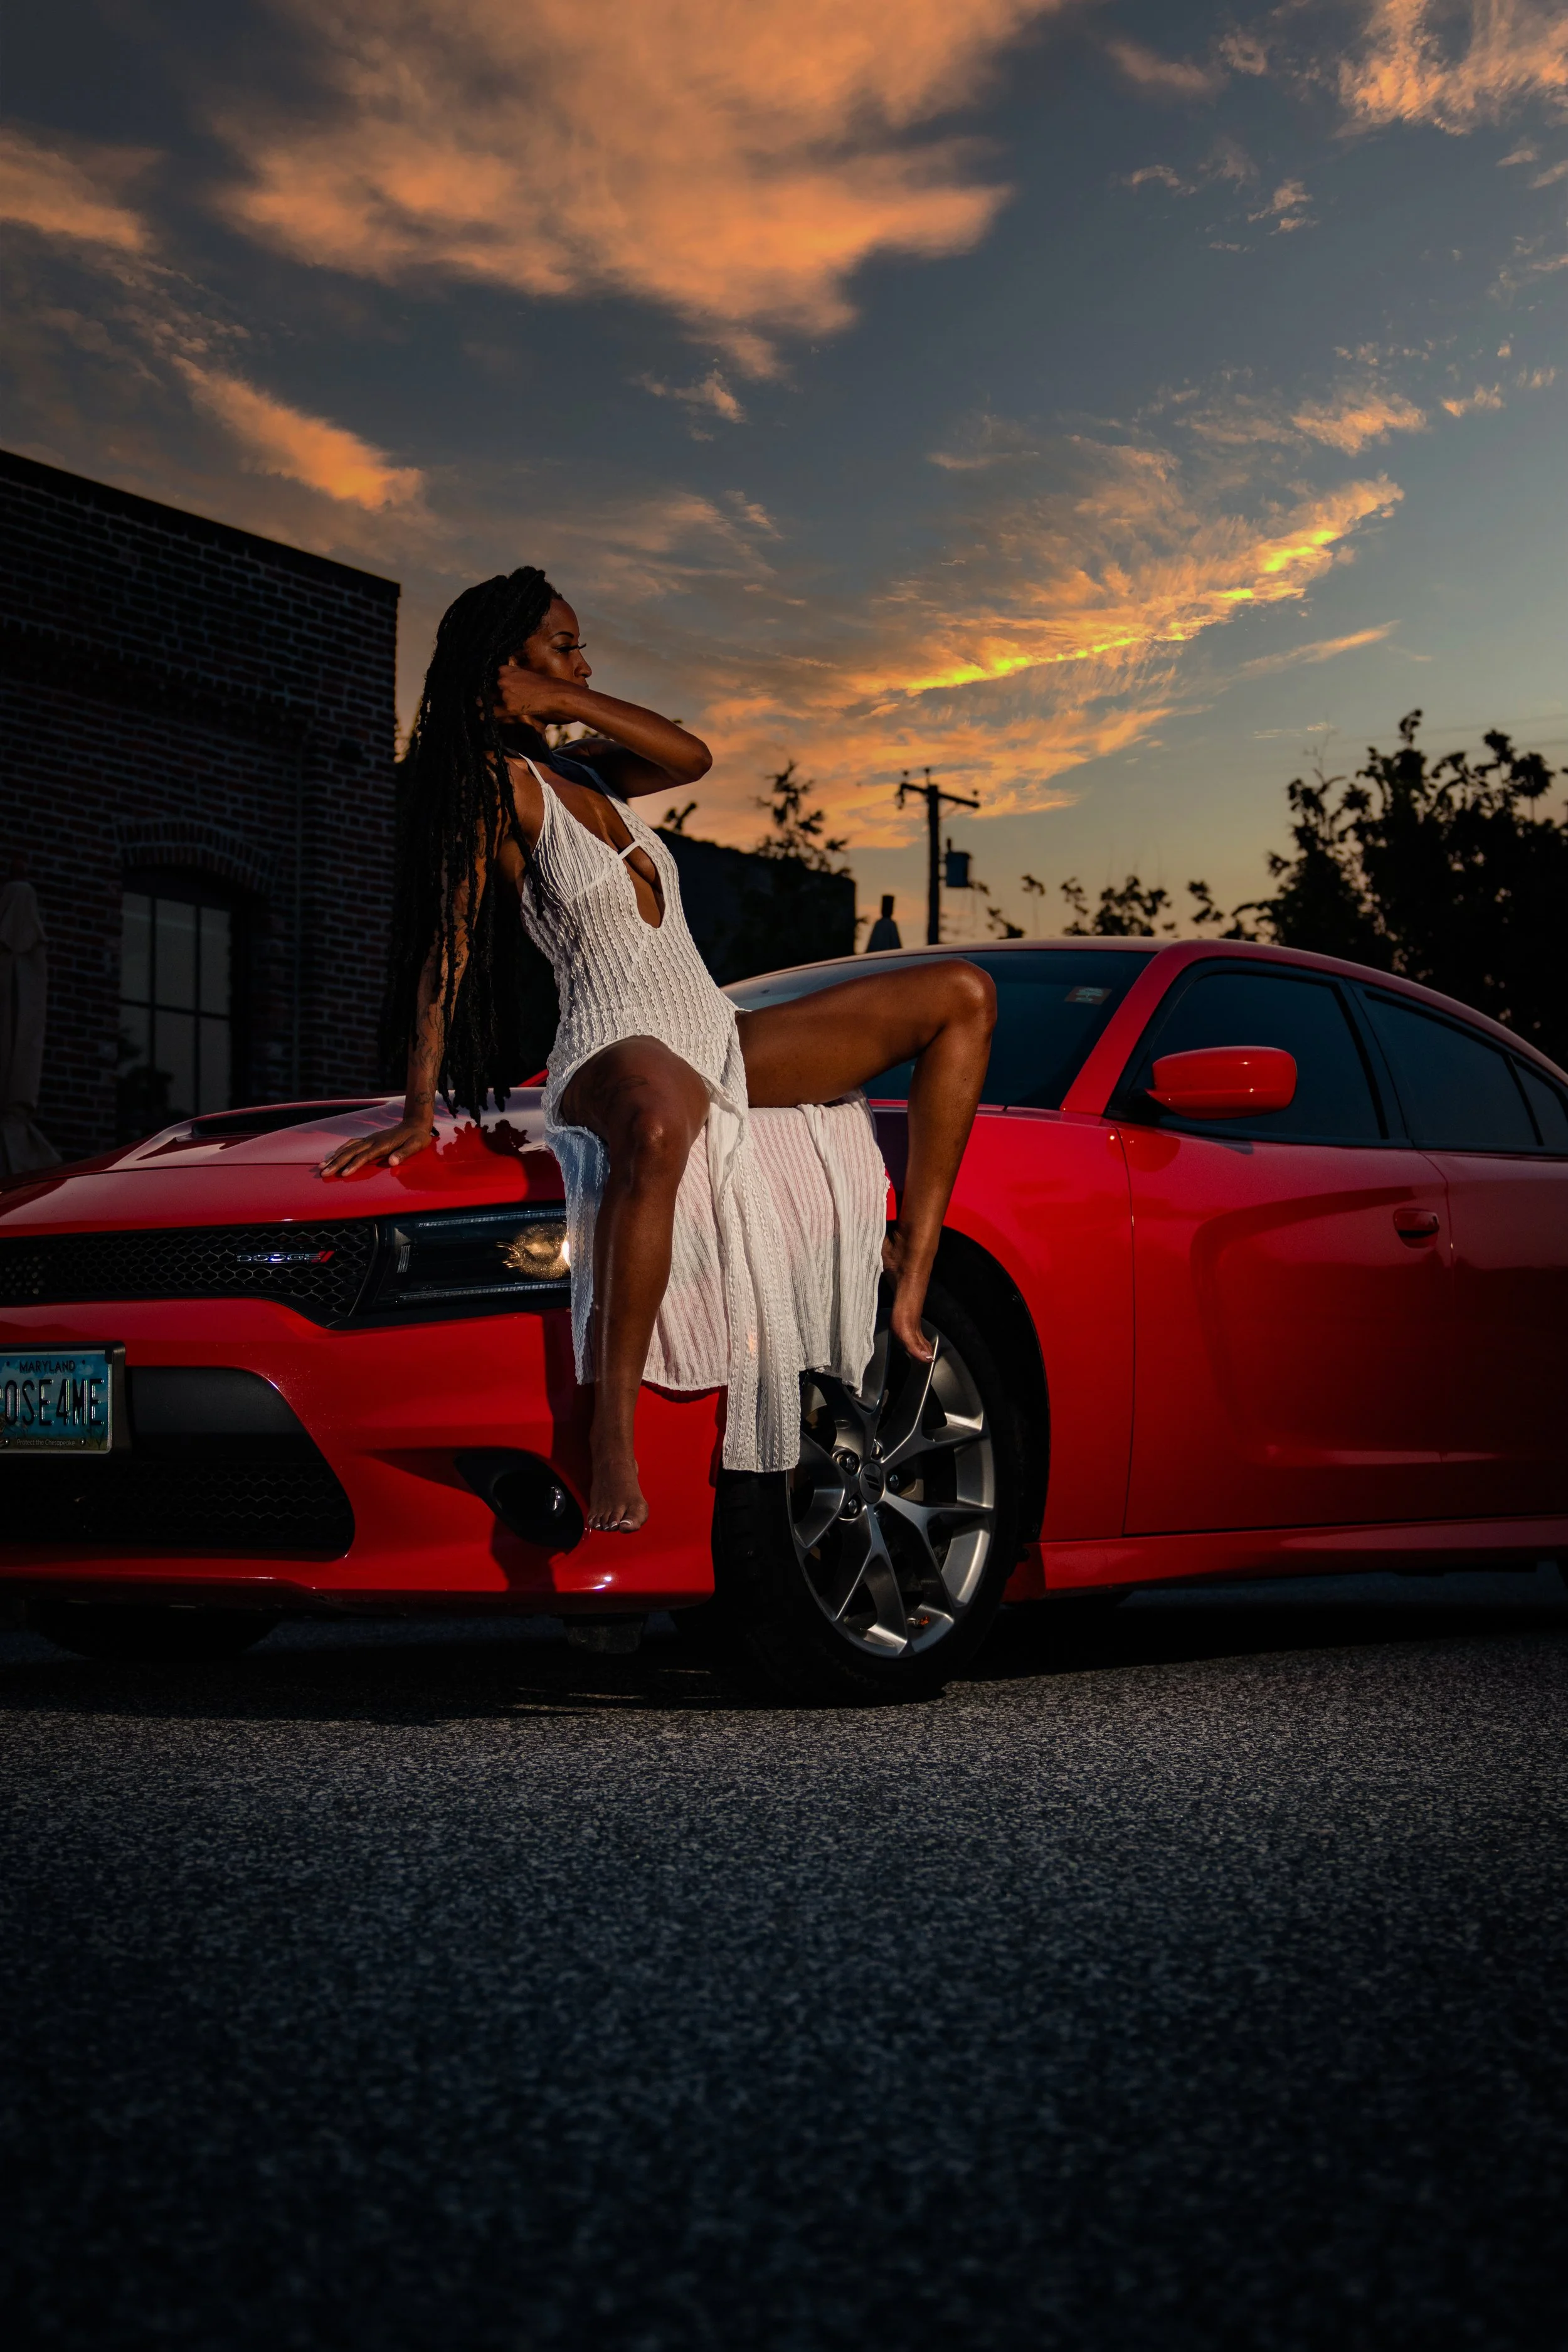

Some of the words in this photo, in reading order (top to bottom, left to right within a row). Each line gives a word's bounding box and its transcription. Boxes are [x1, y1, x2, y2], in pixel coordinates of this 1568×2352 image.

[237, 1253, 321, 1262] DODGE
[19, 1360, 75, 1373] MARYLAND
[0, 1379, 104, 1426] OSE4ME
